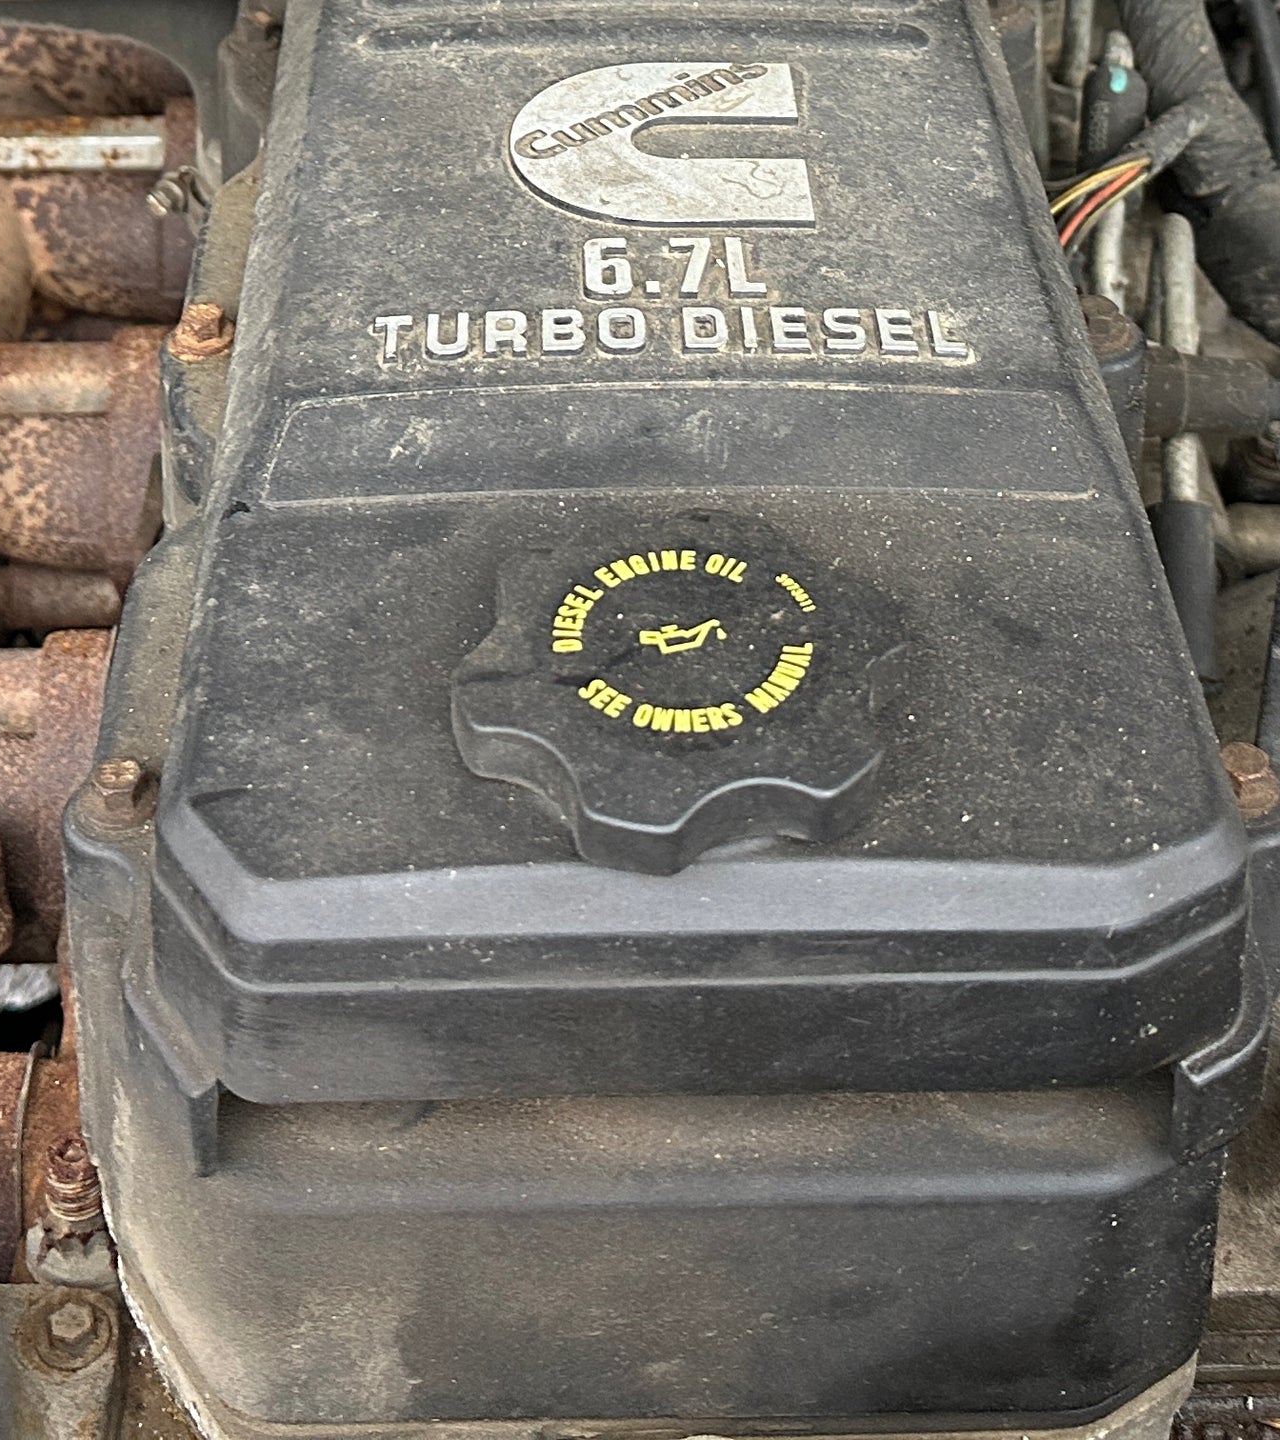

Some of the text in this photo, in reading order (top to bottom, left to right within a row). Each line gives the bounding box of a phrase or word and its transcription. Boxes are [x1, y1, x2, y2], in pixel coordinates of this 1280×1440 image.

[513, 61, 770, 161] Cummins
[582, 236, 768, 301] 6.7L
[372, 306, 970, 362] TURBO DIESEL
[552, 549, 748, 653] DIESEL ENGINE OIL
[577, 641, 815, 733] SEE OWNERS MANUAL
